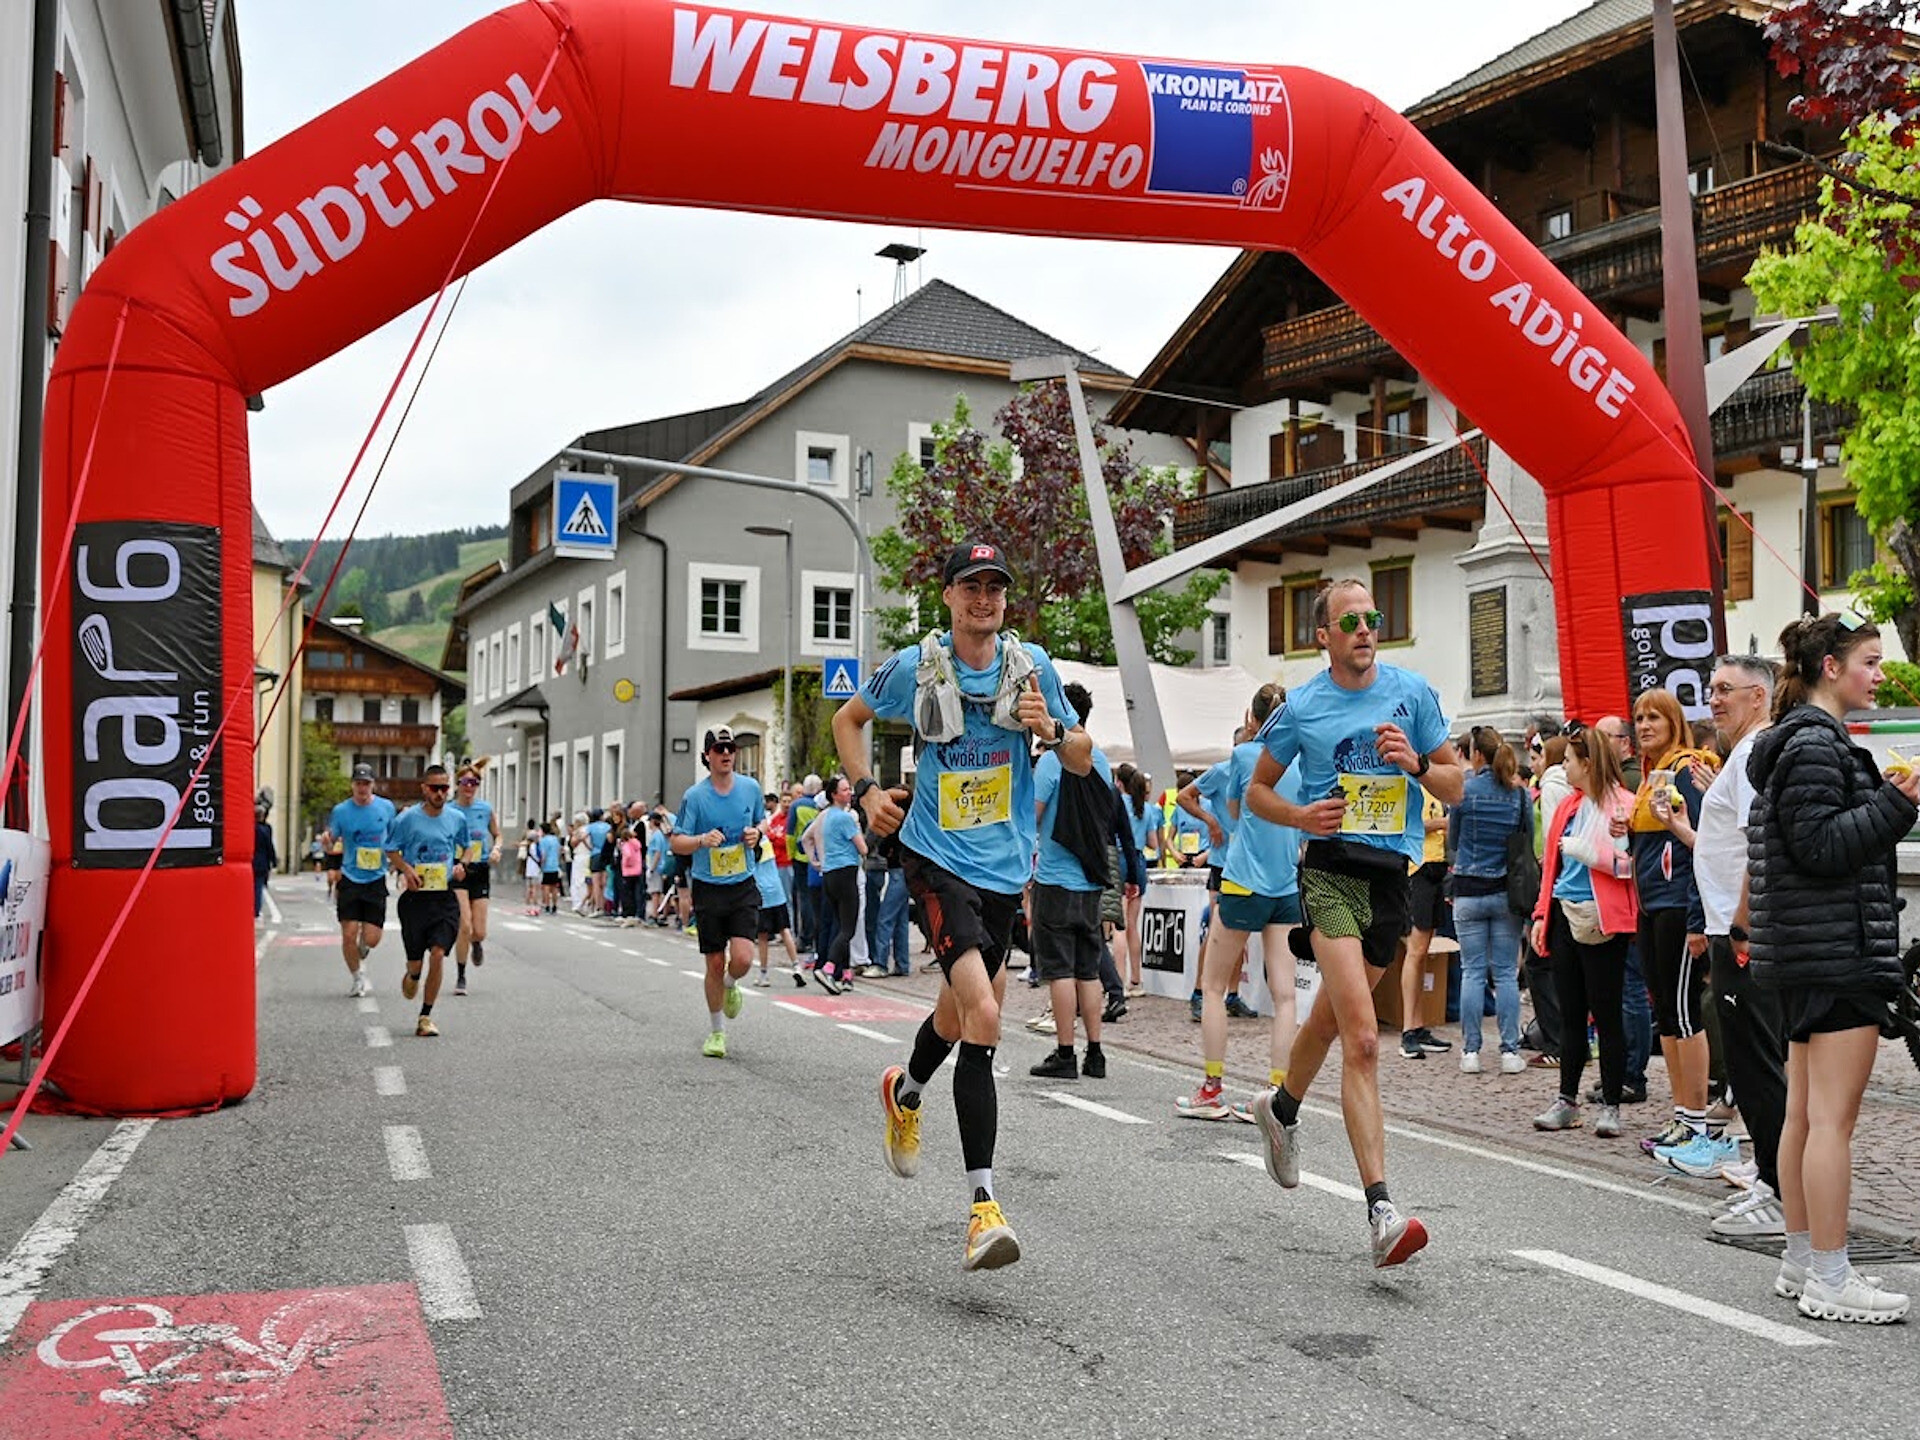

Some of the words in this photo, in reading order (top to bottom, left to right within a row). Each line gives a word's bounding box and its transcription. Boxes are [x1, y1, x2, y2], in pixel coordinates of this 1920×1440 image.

[670, 9, 1117, 133] WELSBERG
[1149, 72, 1283, 103] KRONPLATZ
[1180, 98, 1207, 112] PLAN
[1209, 100, 1223, 112] DE
[1225, 101, 1272, 116] CORONES
[865, 121, 1143, 190] MONGUELFO
[1631, 627, 1659, 669] golf
[1640, 674, 1658, 690] &
[194, 690, 210, 736] run
[190, 743, 209, 762] &
[189, 769, 214, 823] golf
[955, 792, 999, 809] 191447
[1351, 799, 1396, 813] 217207
[1143, 912, 1184, 964] par6
